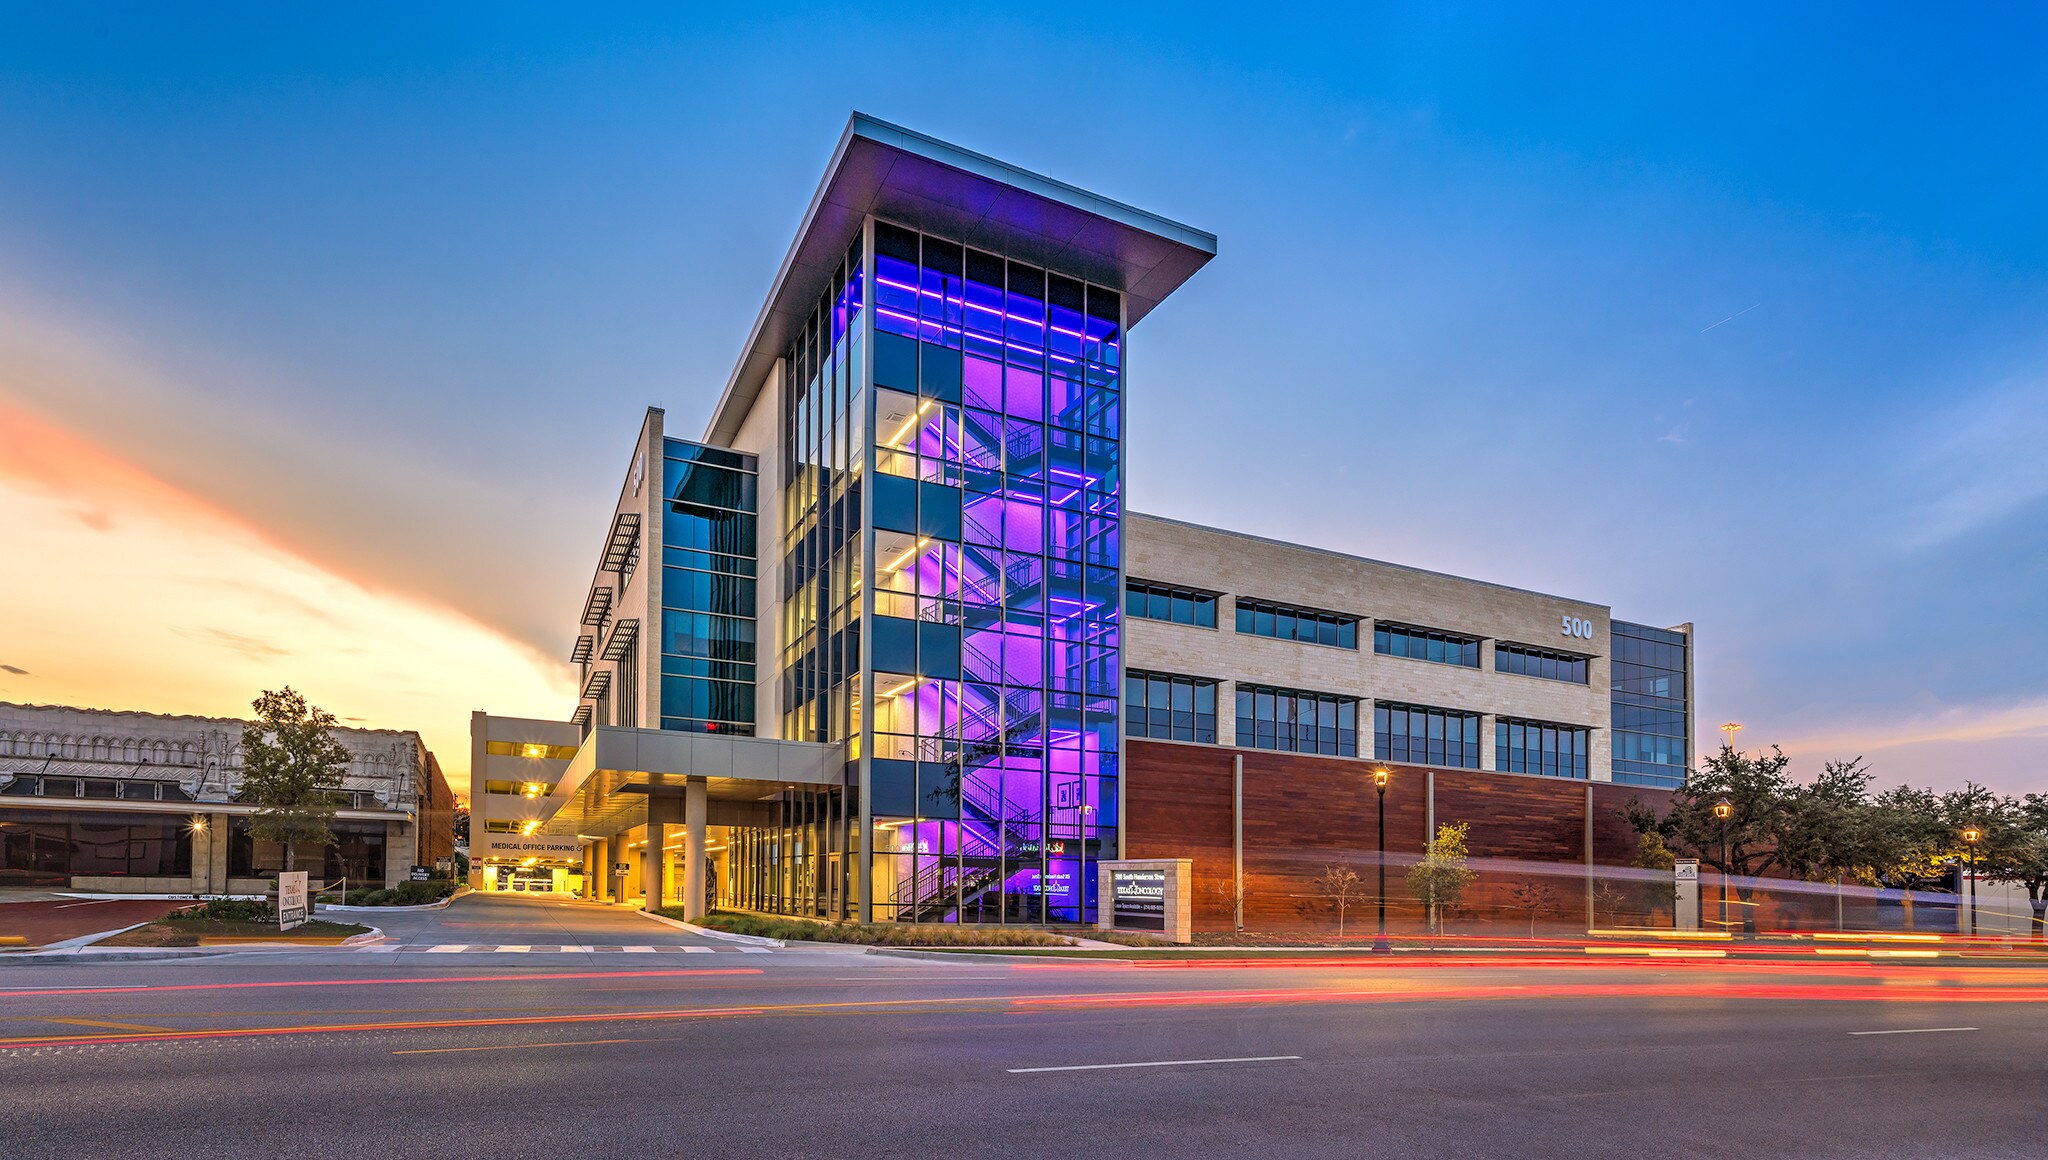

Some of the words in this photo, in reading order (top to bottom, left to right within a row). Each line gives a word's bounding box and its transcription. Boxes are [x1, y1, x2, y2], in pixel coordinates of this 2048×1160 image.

[1561, 615, 1593, 640] 500
[491, 842, 521, 850] MEDICAL
[522, 843, 545, 851] OFFICE
[546, 844, 575, 852] PARKING
[285, 884, 301, 895] TEXAS
[1117, 886, 1130, 894] TEXAS
[1136, 887, 1164, 896] ONCOLOGY
[283, 908, 304, 922] ENTRANCE
